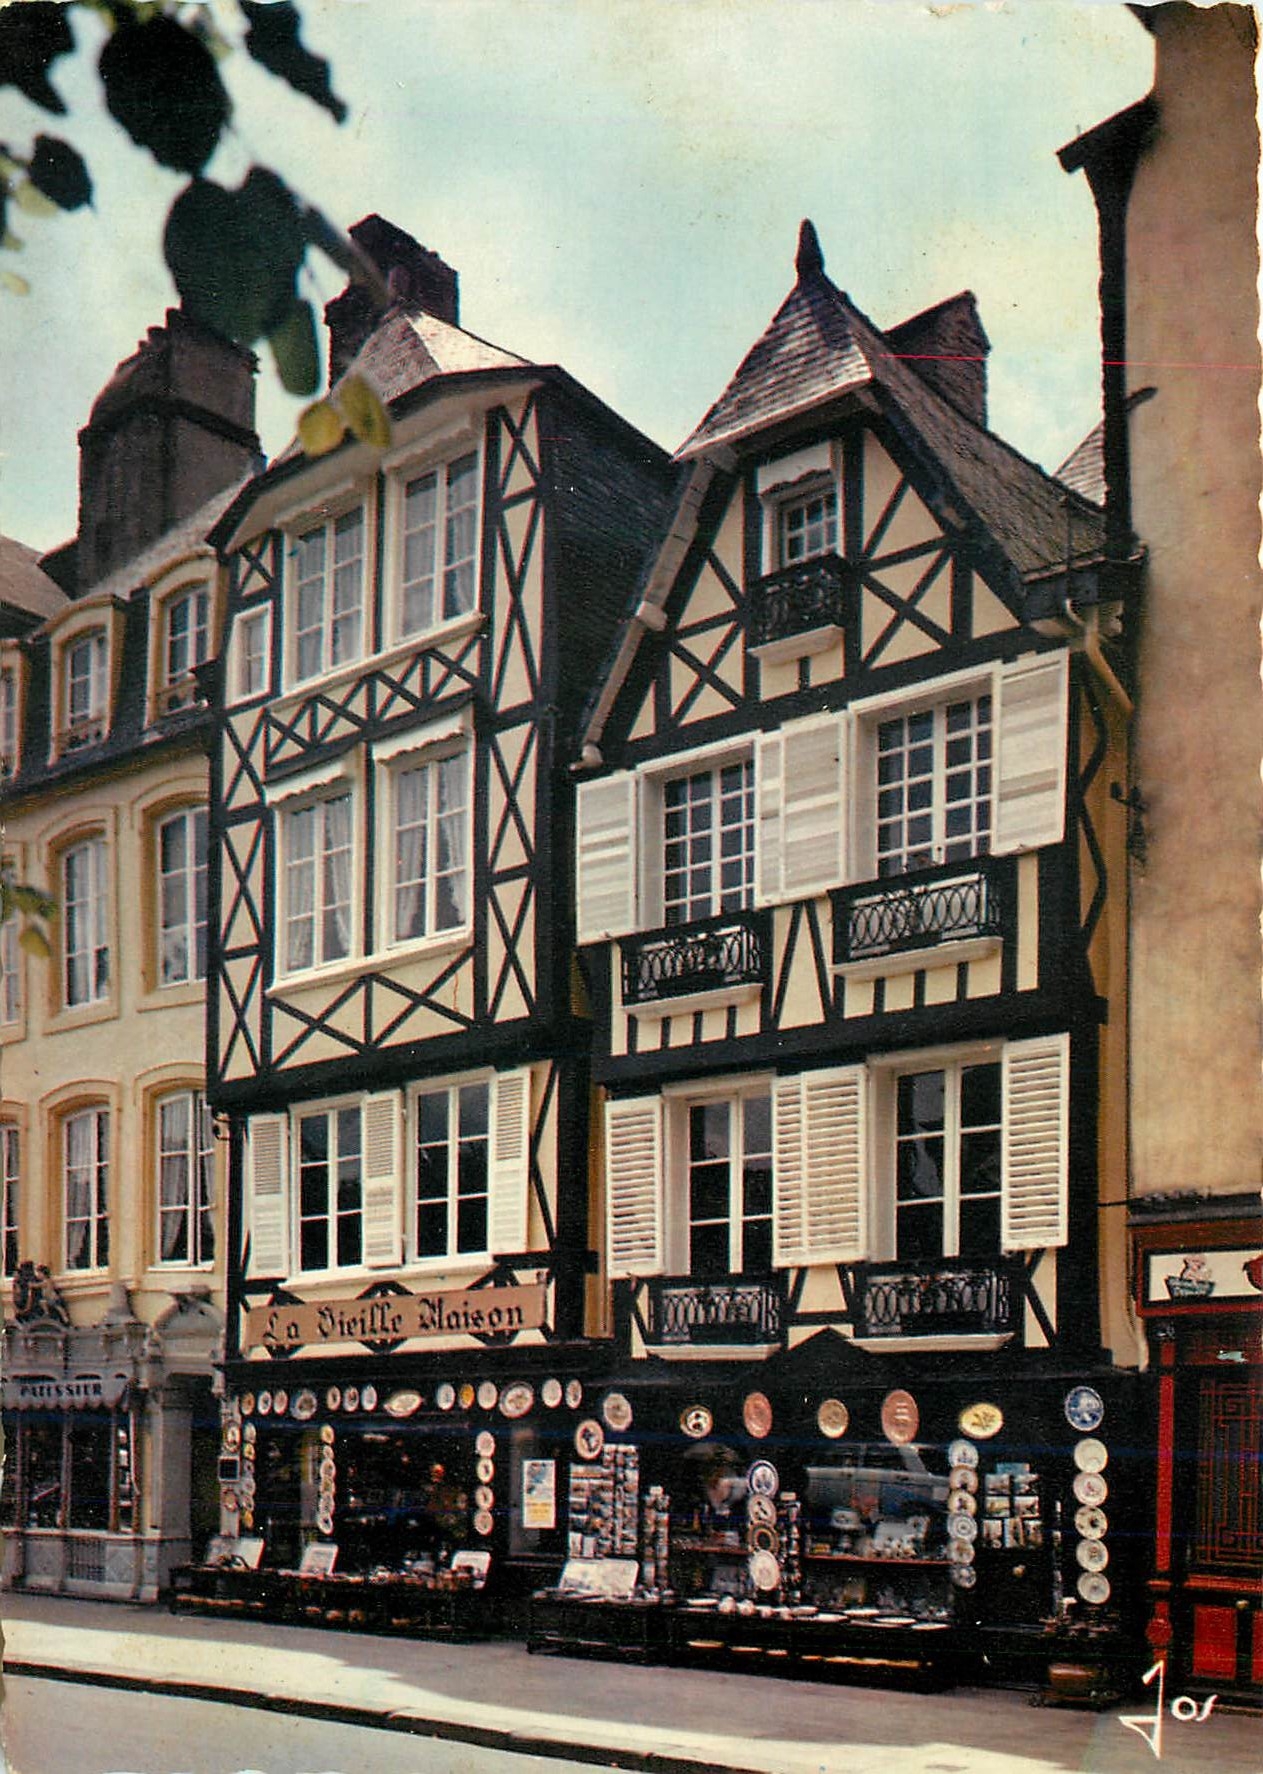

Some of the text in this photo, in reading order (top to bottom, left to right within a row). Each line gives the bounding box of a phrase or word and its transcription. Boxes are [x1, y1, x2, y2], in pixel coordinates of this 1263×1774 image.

[263, 1296, 524, 1341] La Vieille Maison
